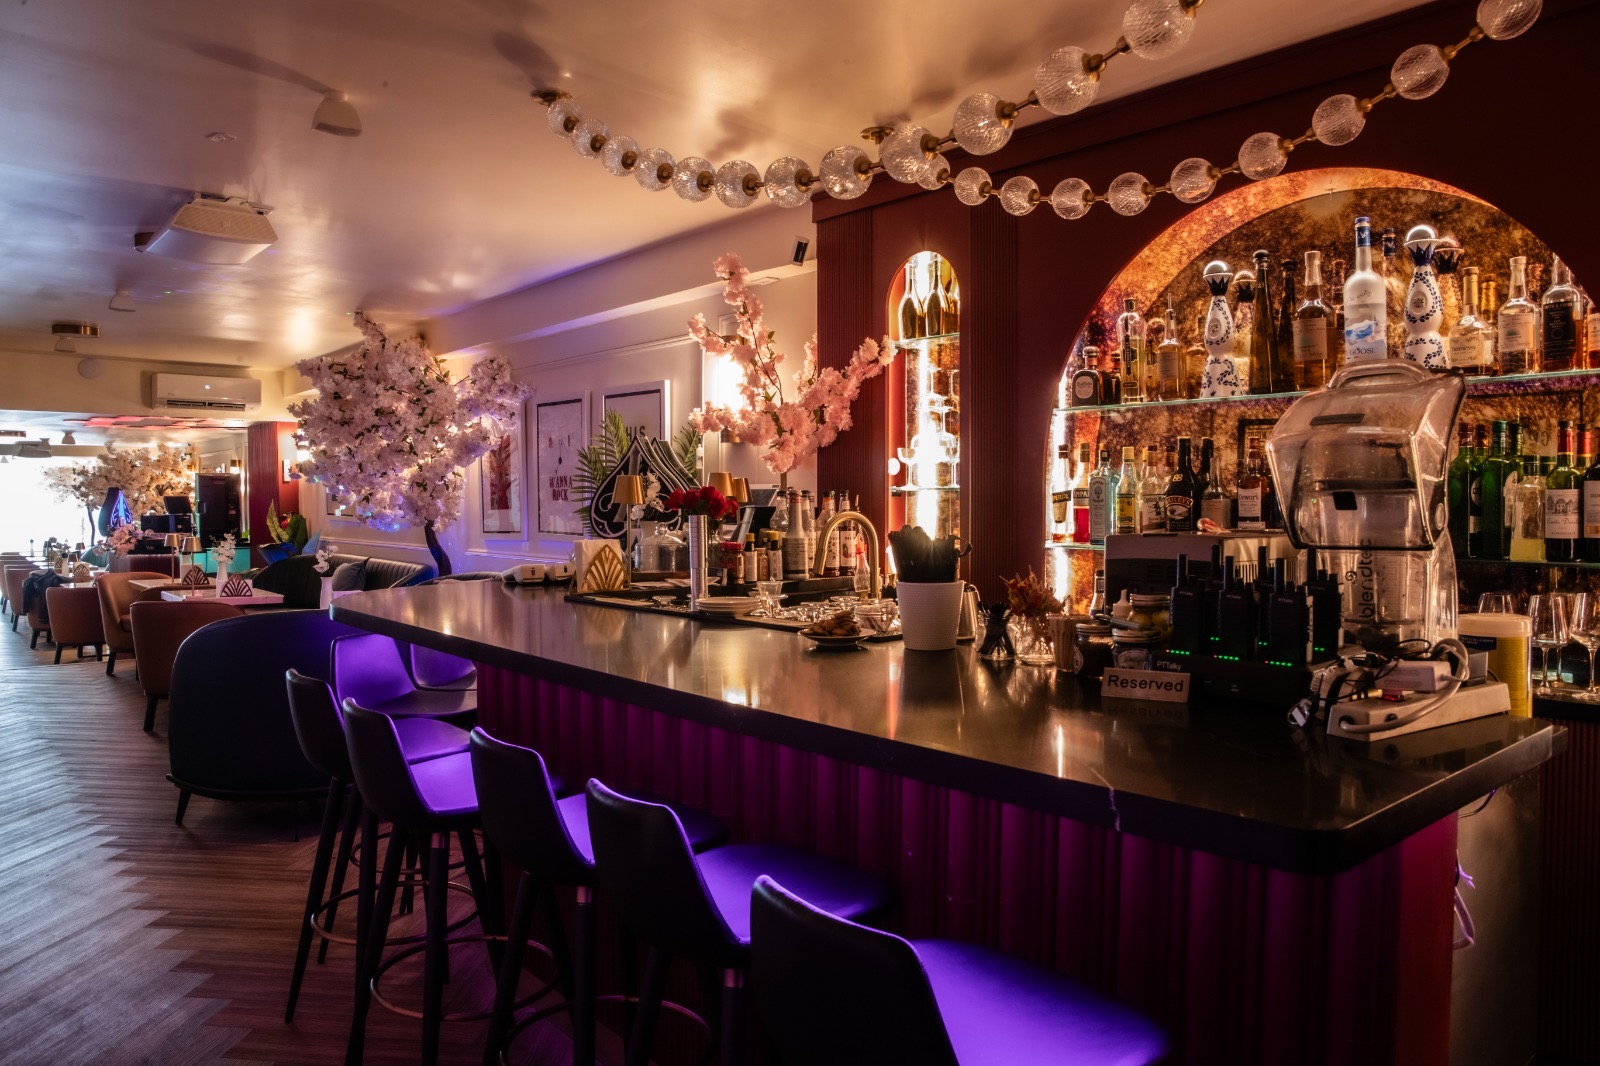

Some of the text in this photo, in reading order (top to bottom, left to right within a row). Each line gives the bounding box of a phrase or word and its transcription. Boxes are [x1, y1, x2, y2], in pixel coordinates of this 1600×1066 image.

[626, 425, 646, 442] HIS
[549, 476, 573, 488] WANNA
[552, 488, 569, 501] ROCK
[1053, 493, 1070, 502] PEROL
[1074, 490, 1091, 498] AMPA
[1156, 661, 1182, 672] PTTalky
[1107, 674, 1184, 693] Reserved
